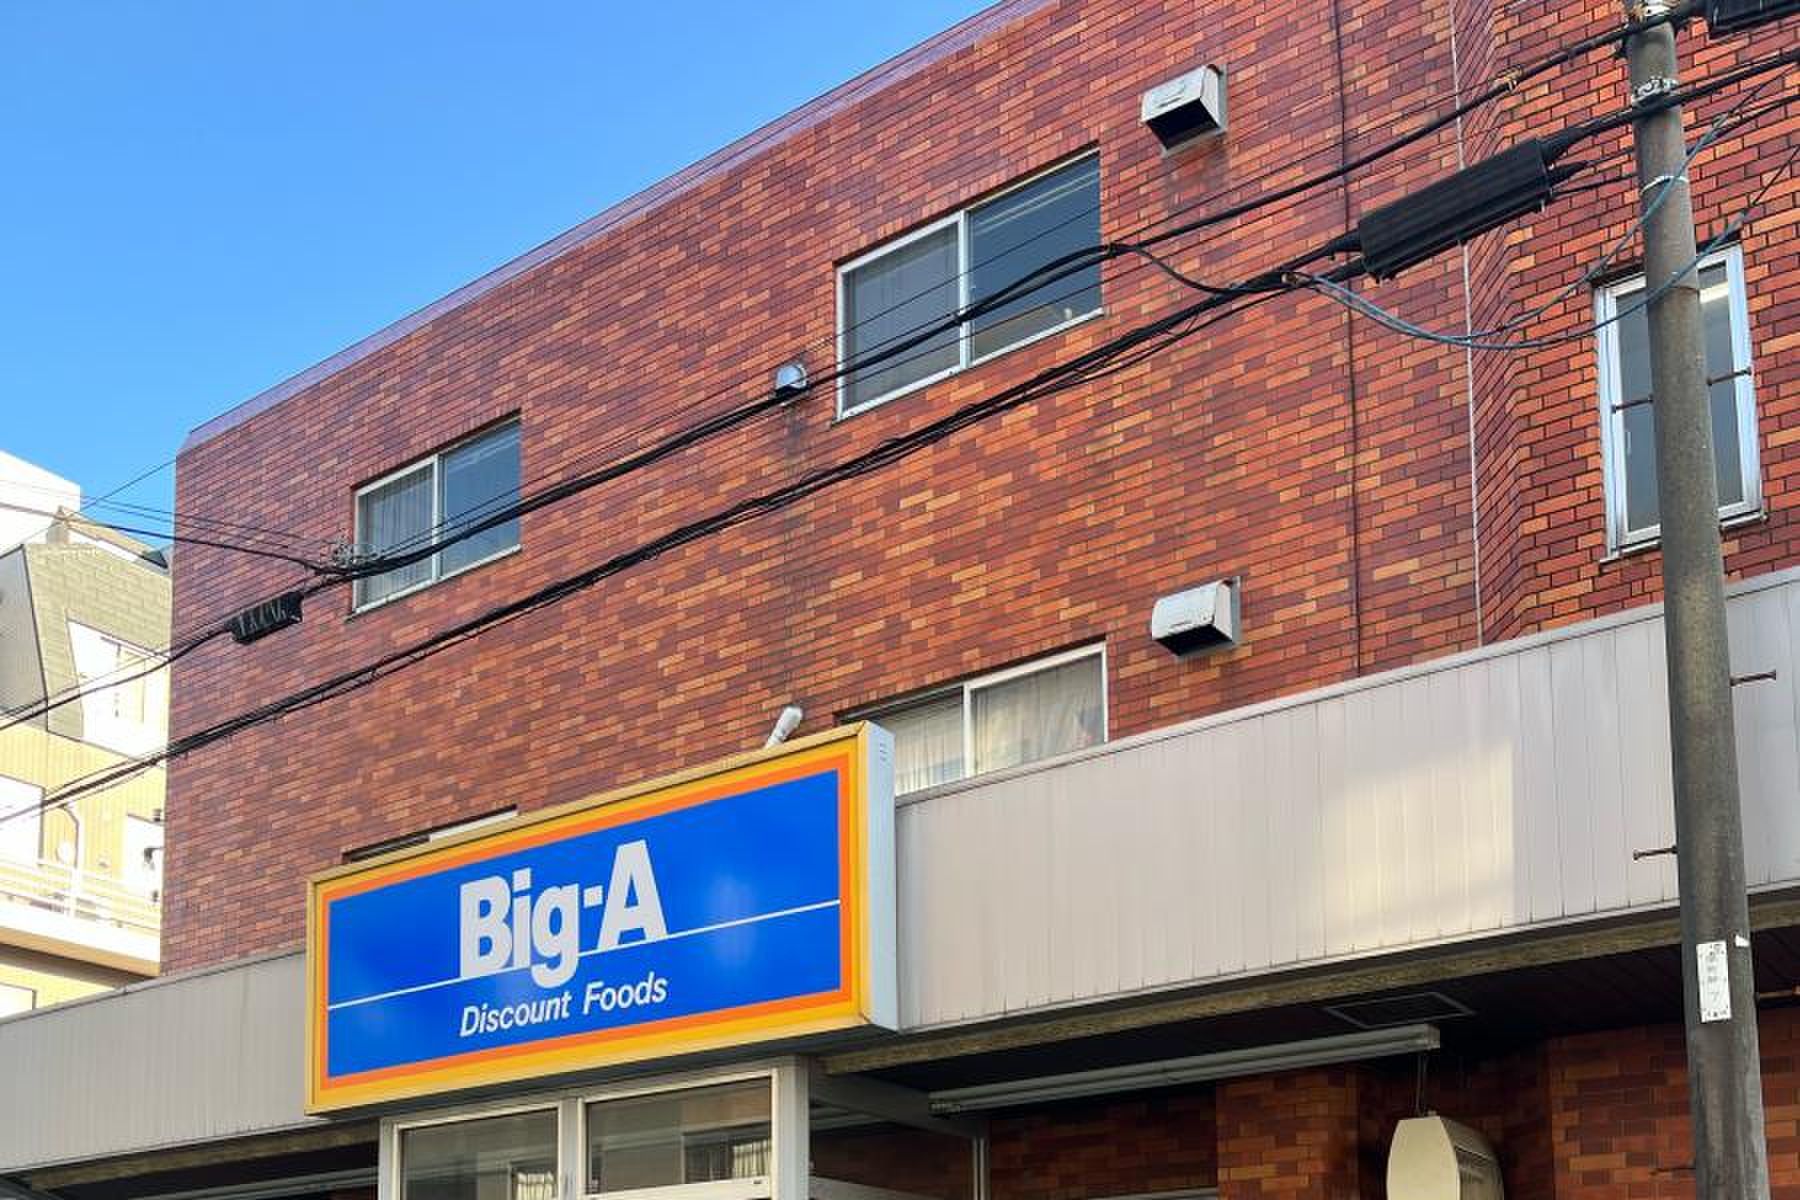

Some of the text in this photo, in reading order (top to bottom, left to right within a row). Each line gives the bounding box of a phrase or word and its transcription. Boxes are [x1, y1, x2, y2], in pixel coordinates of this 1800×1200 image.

[459, 839, 668, 988] Big-A
[459, 970, 668, 1038] Discount Foods
